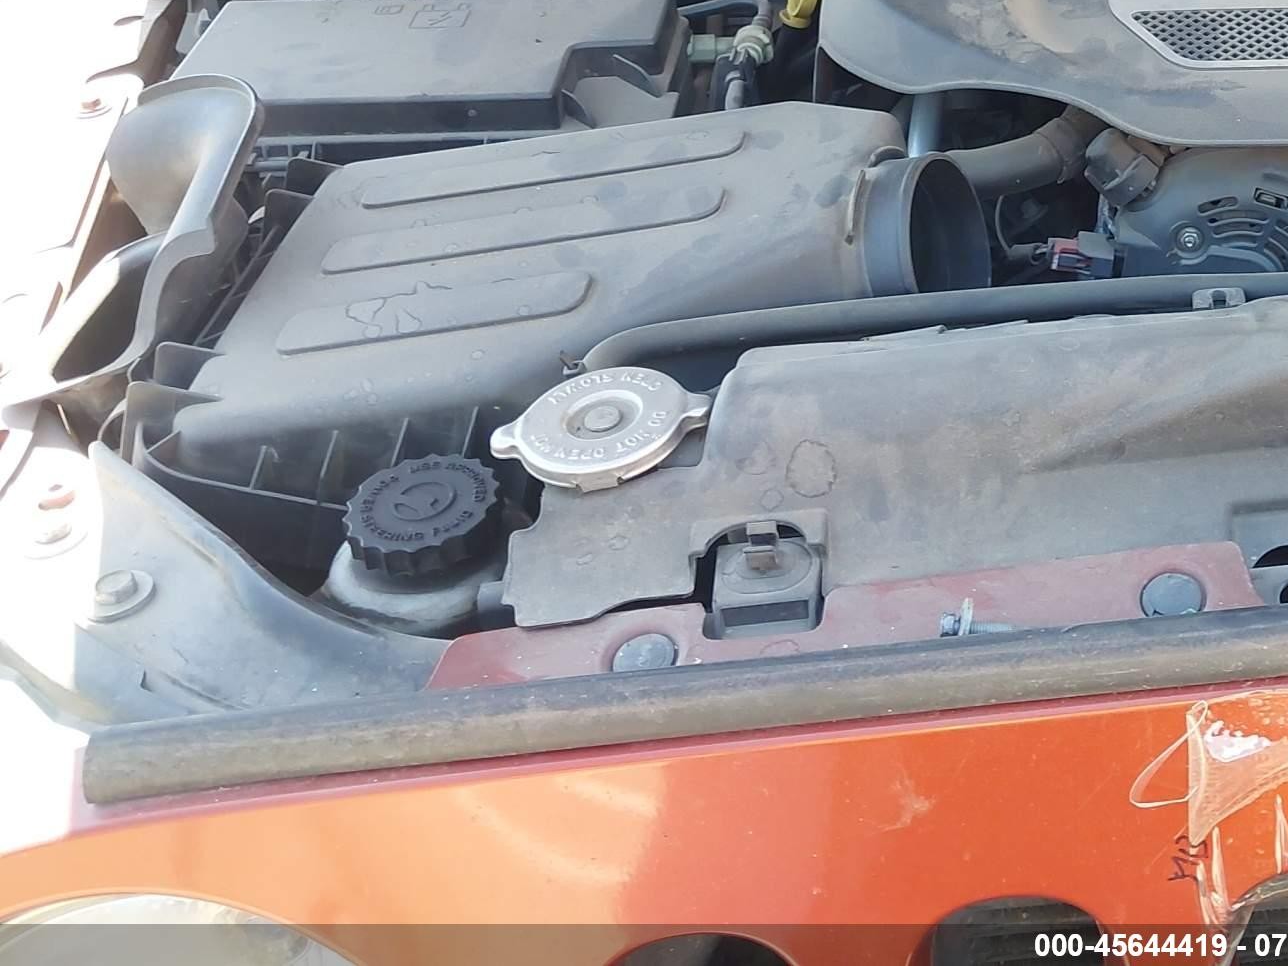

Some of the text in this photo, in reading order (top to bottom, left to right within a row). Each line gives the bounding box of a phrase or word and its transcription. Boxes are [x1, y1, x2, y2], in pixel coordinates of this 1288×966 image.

[546, 371, 662, 405] OPEN SLOWLY
[650, 410, 667, 427] DO
[554, 448, 605, 460] OPEN
[616, 432, 652, 455] NOT
[409, 461, 489, 504] USE APPROVED
[360, 513, 424, 542] STEERING
[432, 510, 473, 538] FLUID
